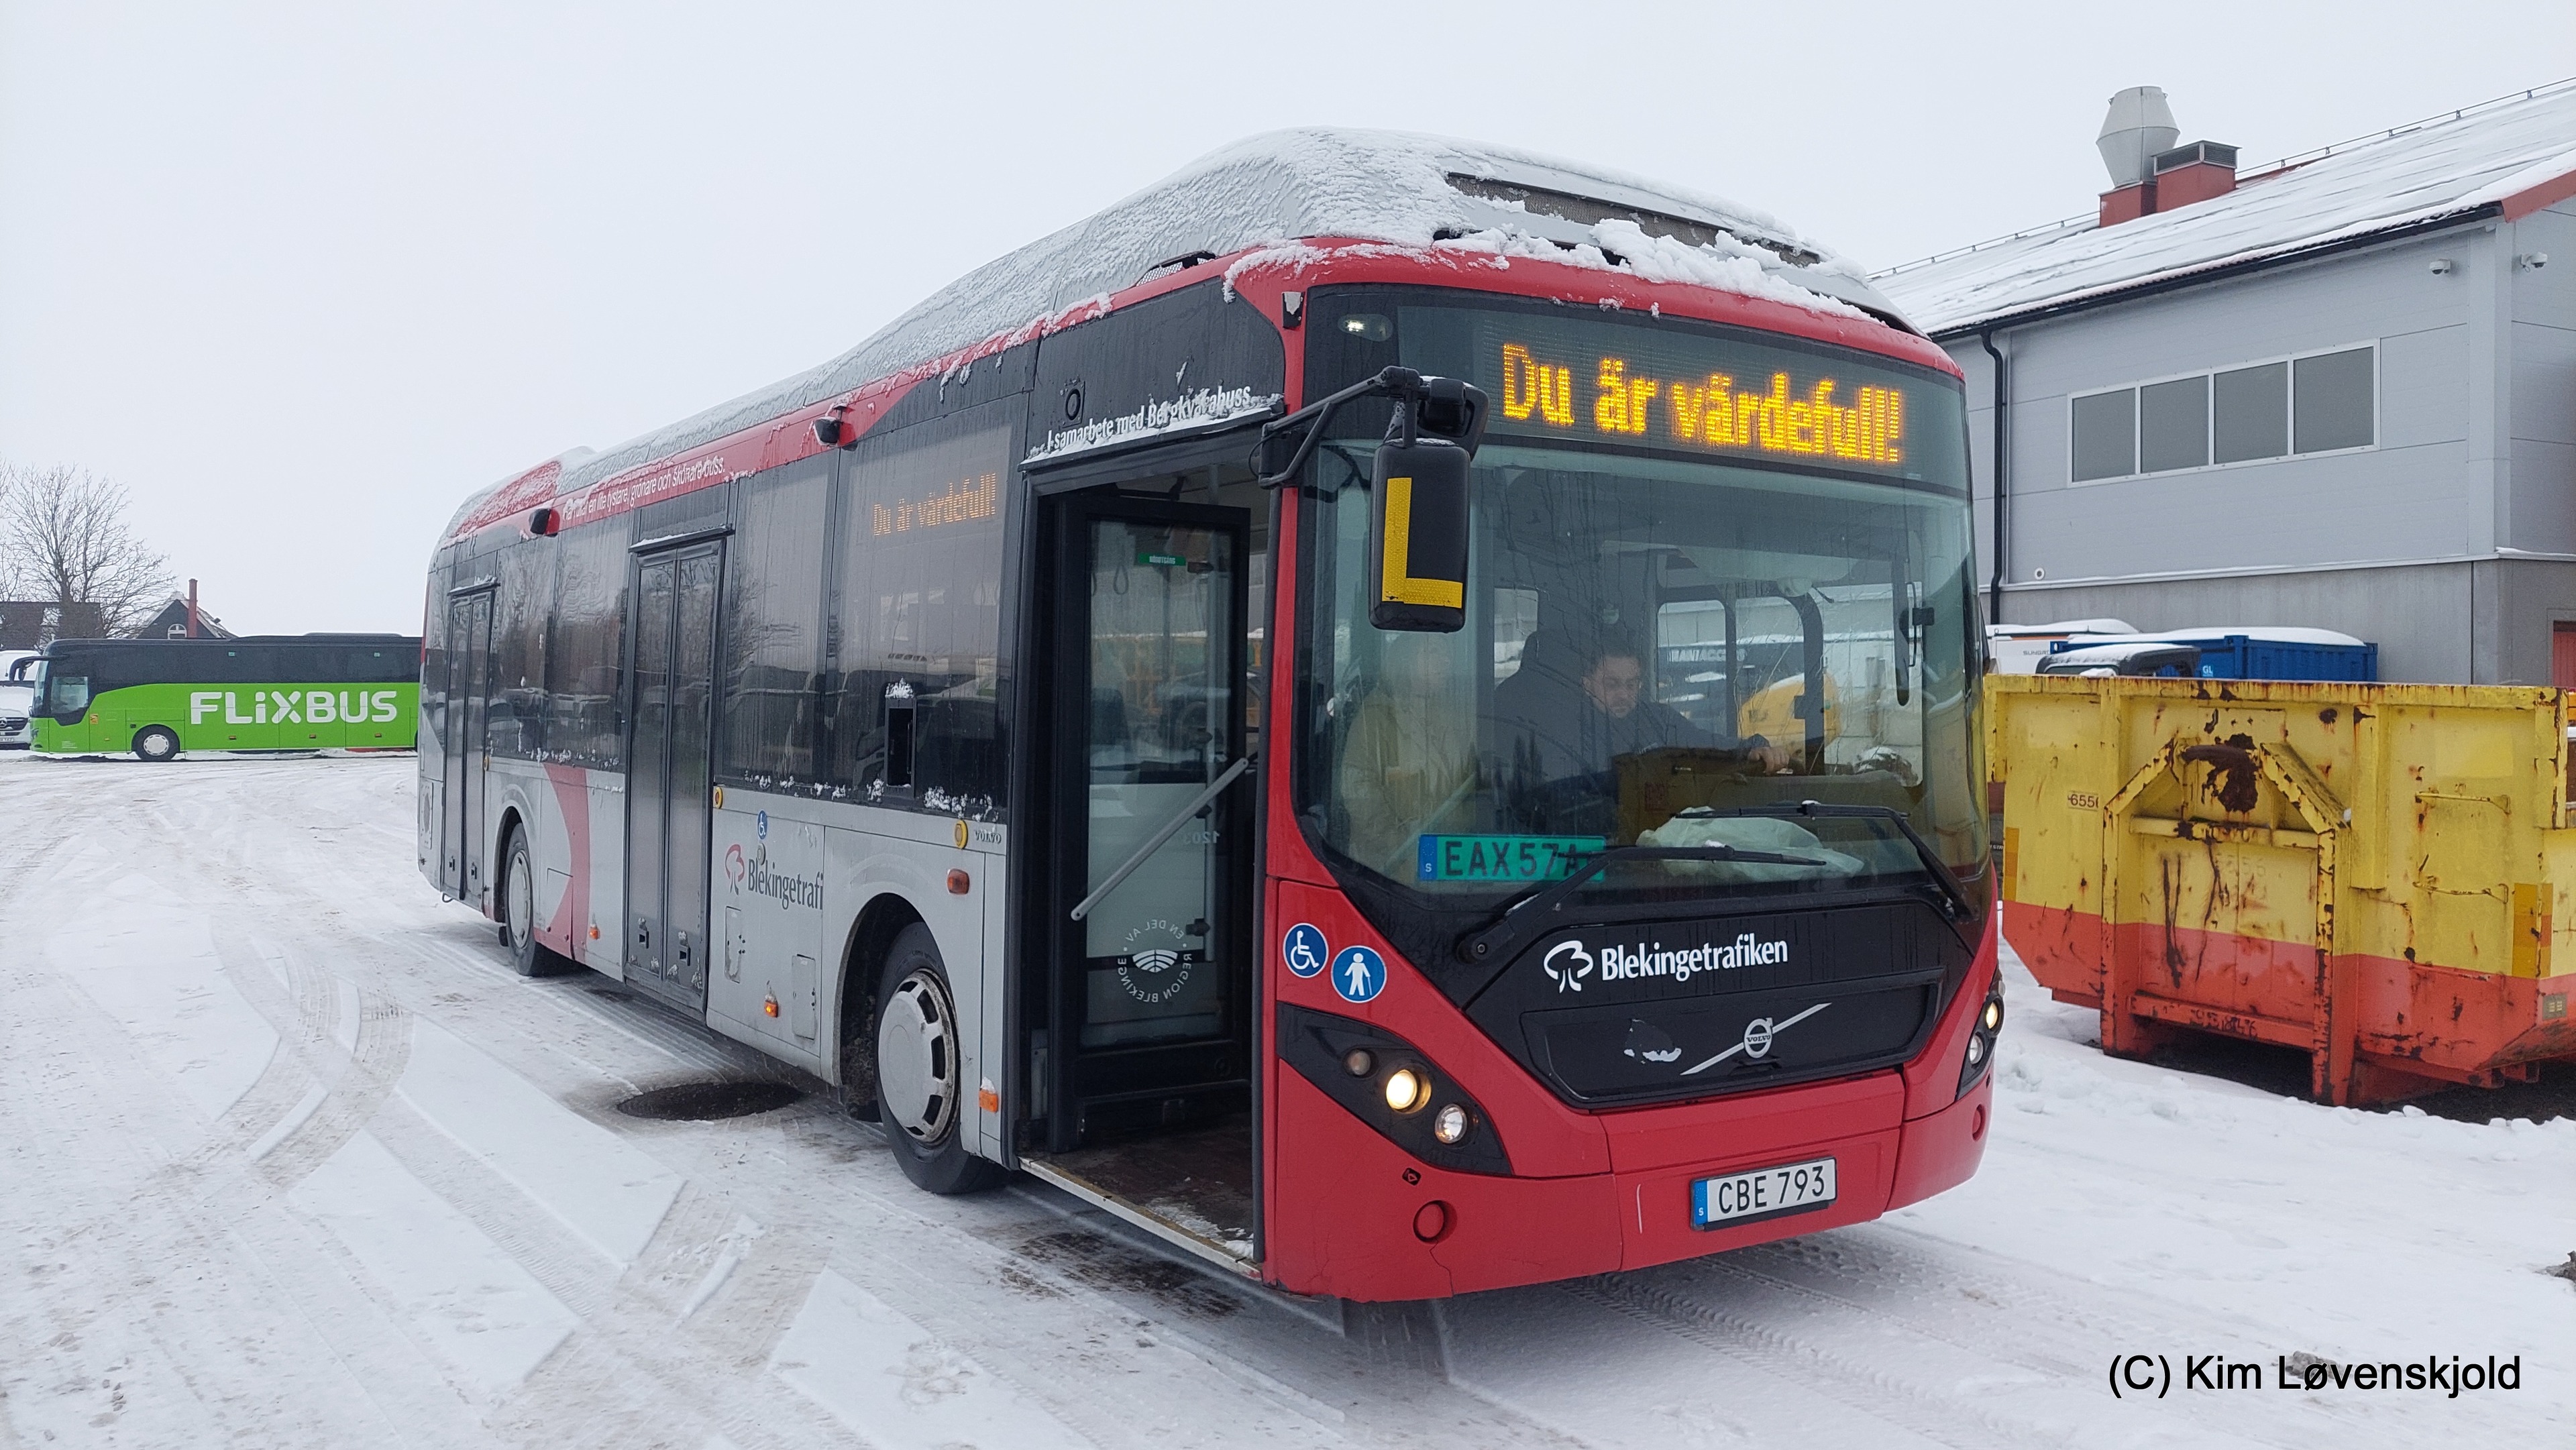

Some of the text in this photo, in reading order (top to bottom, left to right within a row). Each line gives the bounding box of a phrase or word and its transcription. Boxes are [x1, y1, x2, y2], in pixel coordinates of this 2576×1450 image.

[1502, 342, 1902, 463] Du är värdefull!
[1054, 419, 1114, 450] samarbete
[1116, 404, 1144, 435] med
[658, 469, 671, 491] och
[874, 473, 996, 536] Du är värdefull!
[975, 830, 1002, 844] VOLVO
[1425, 862, 1432, 873] S
[1445, 840, 1510, 876] EAX
[1601, 932, 1788, 981] Blekingetrafiken
[1746, 1034, 1771, 1043] VOLVO
[1698, 1165, 1825, 1217] S CBE 793
